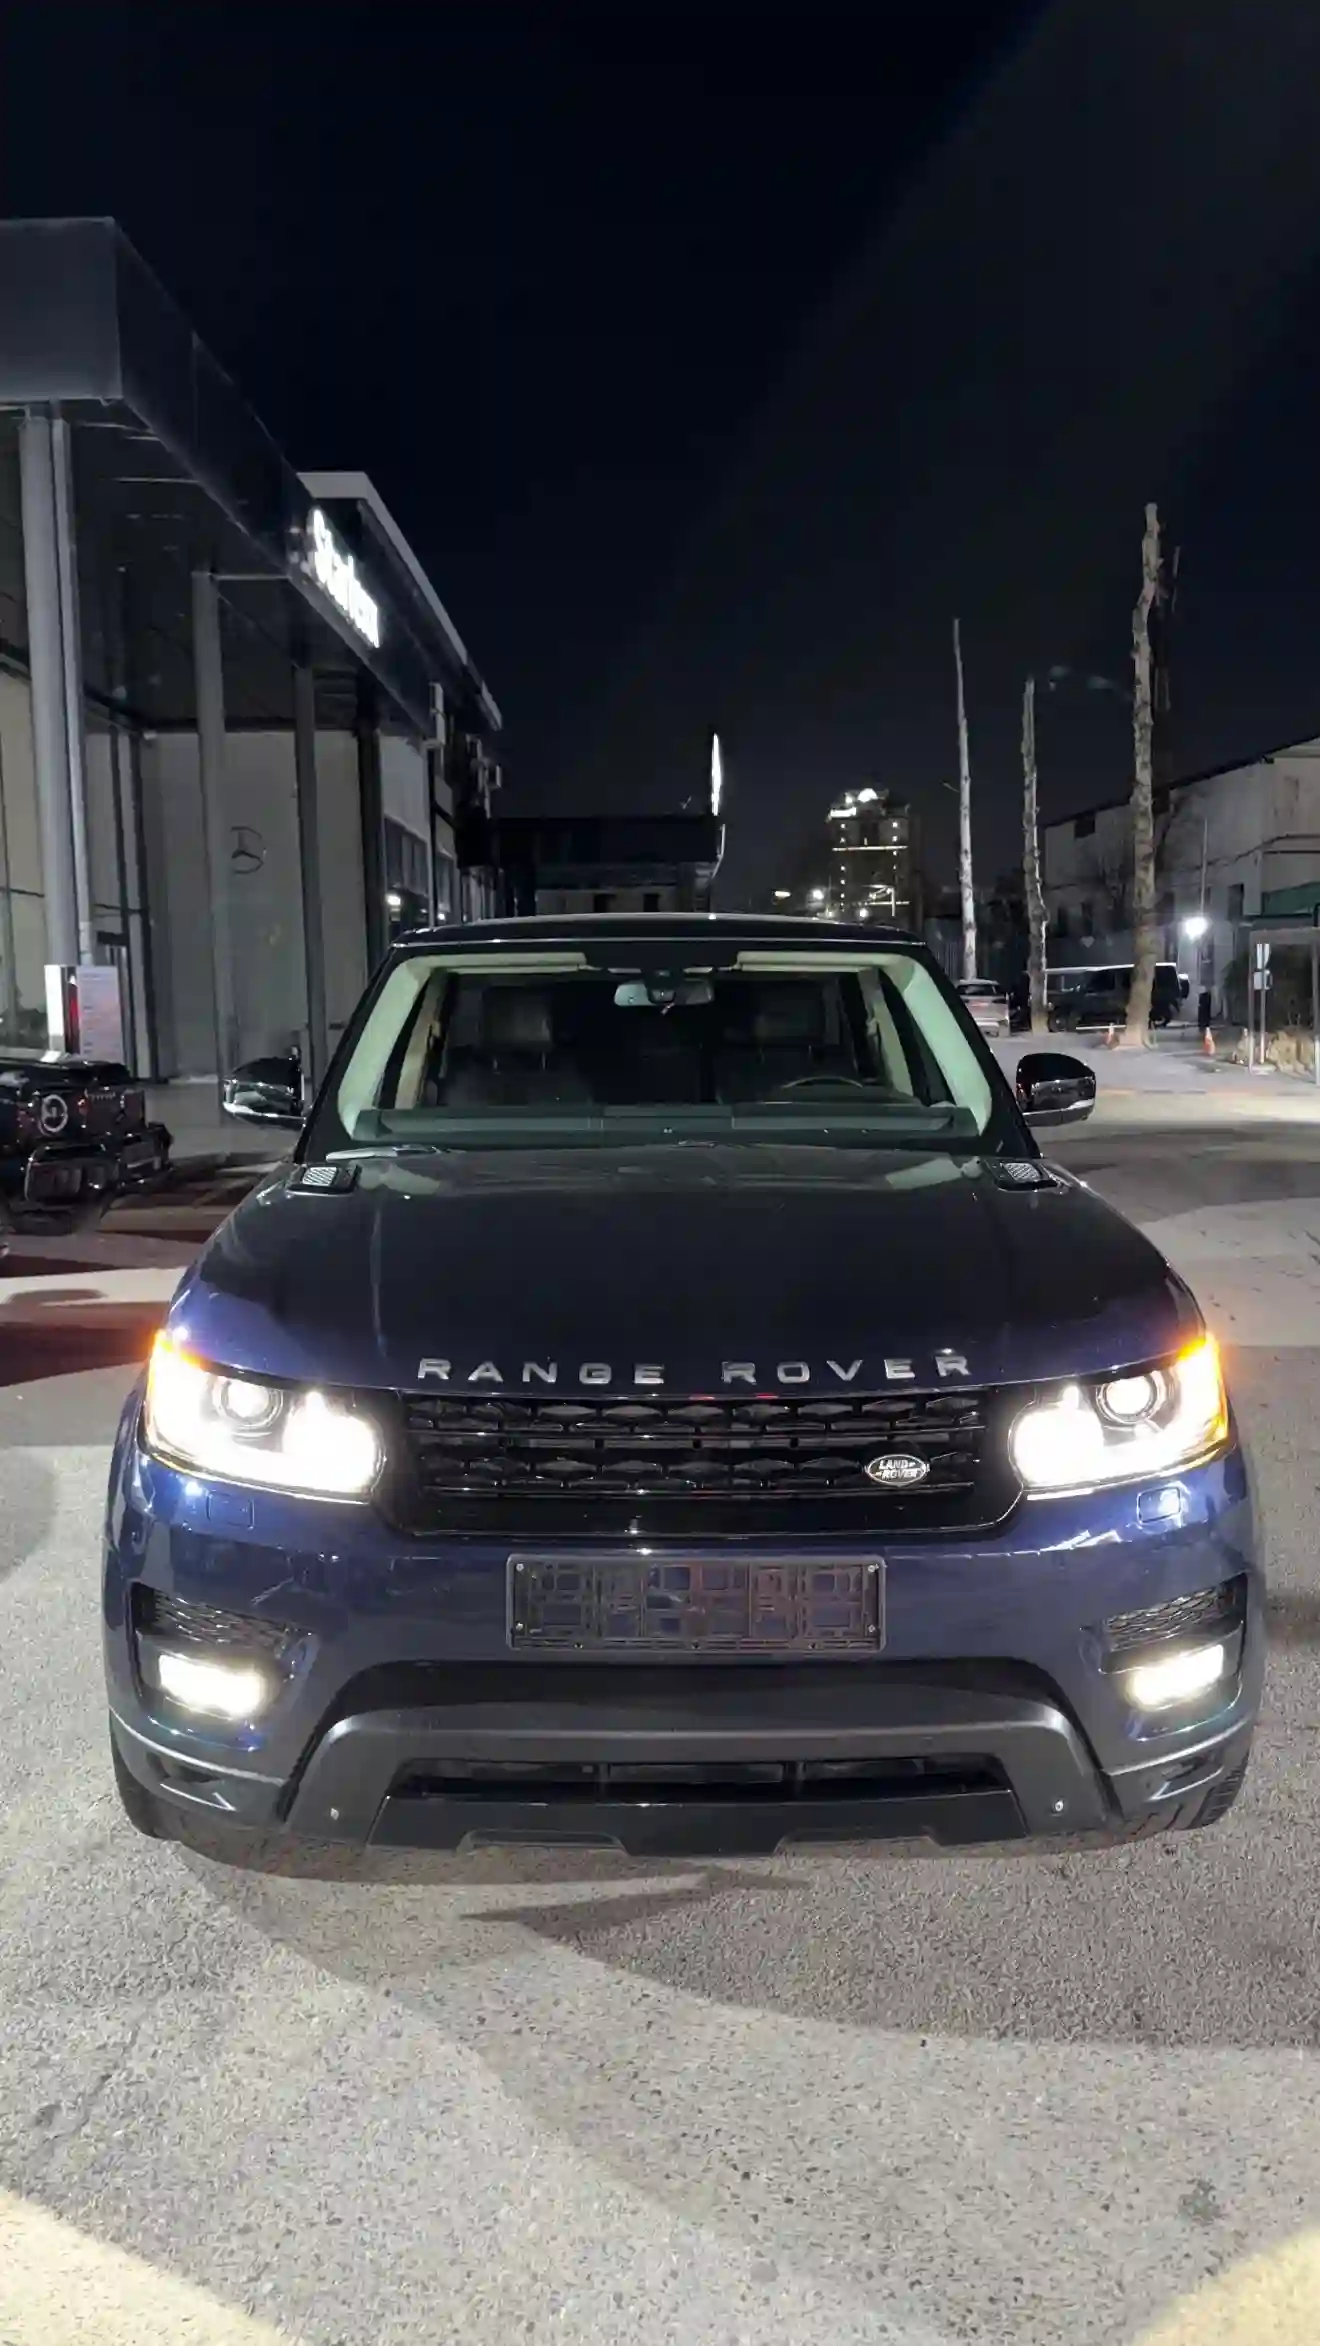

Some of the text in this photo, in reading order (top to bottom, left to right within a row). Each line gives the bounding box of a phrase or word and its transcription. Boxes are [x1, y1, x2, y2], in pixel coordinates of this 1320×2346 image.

[417, 1355, 971, 1385] RANGE ROVER
[878, 1459, 909, 1470] LAND
[881, 1468, 919, 1480] ROVER
